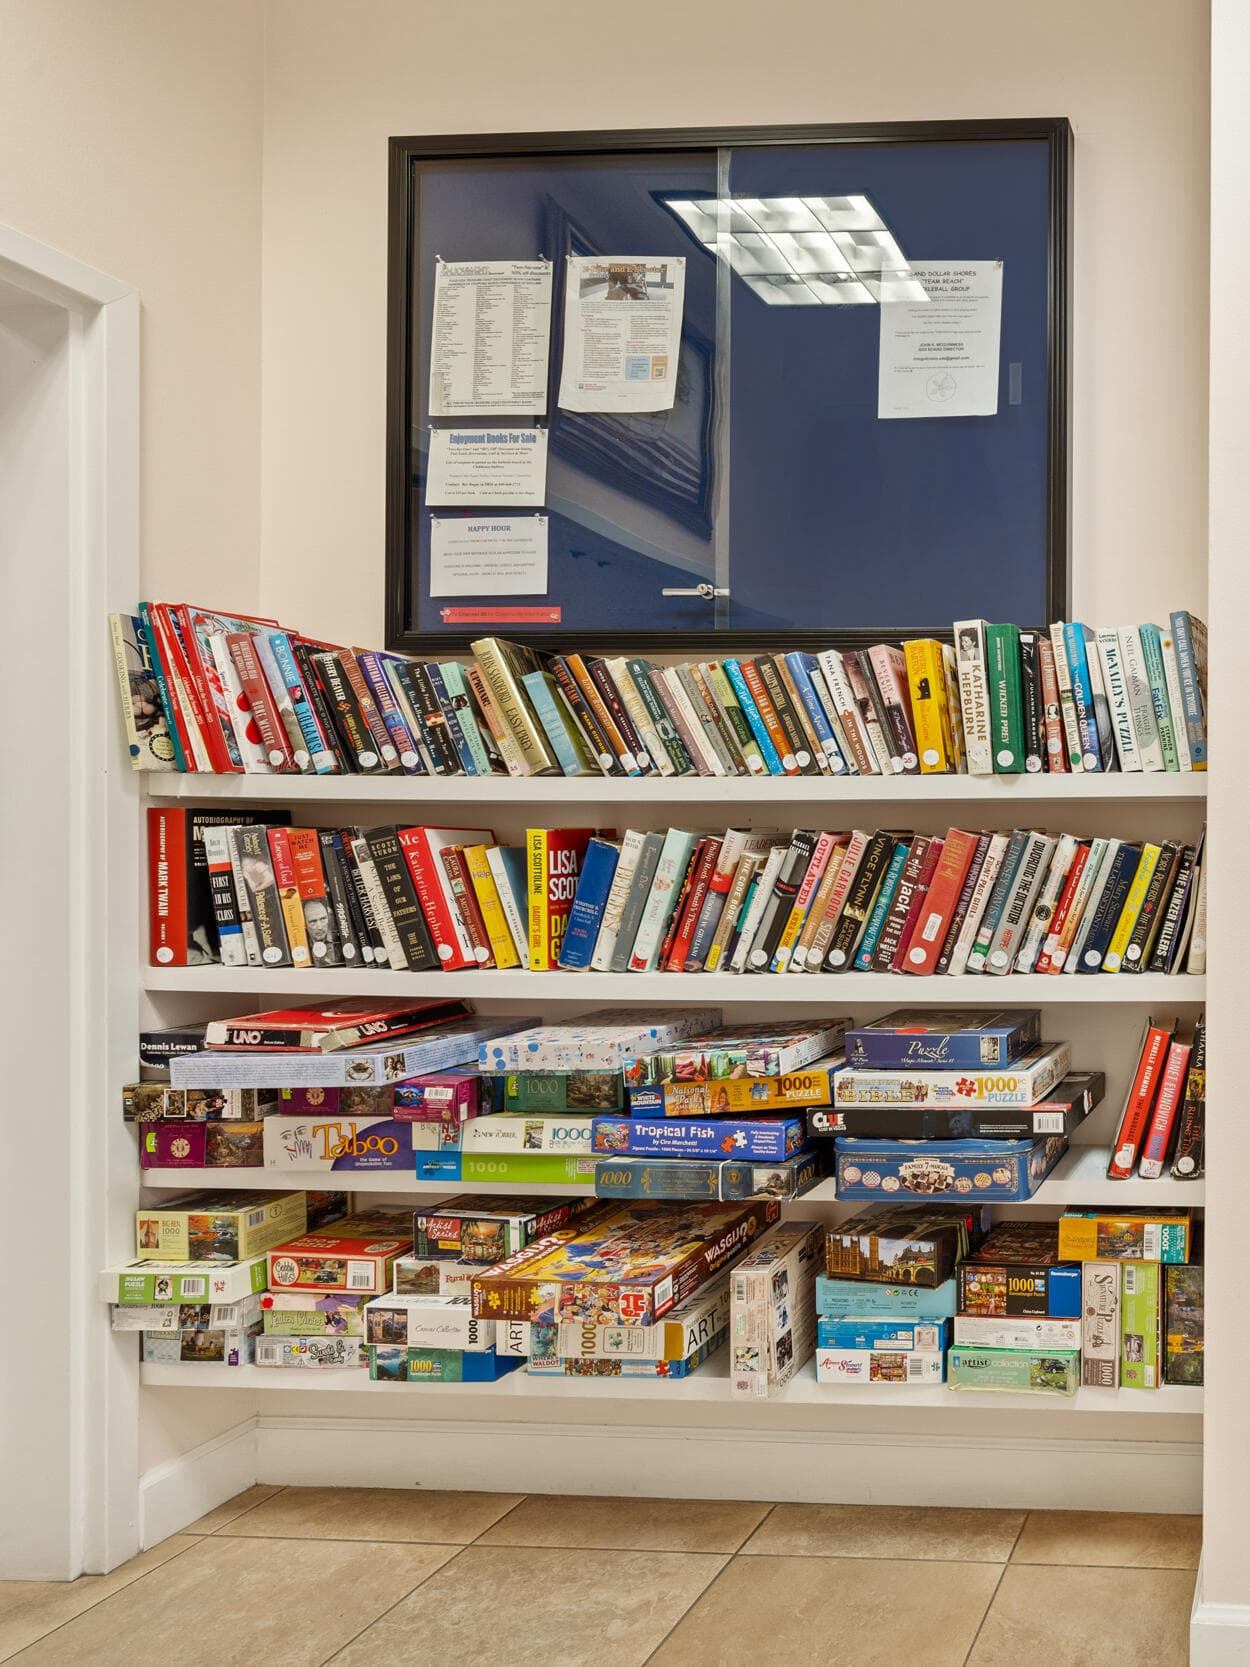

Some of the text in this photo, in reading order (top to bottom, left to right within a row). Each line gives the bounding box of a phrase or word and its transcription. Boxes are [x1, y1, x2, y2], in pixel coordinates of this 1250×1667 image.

[450, 433, 536, 445] Enjoyment Books For Sale
[276, 644, 296, 683] BONNIE
[469, 669, 492, 708] UPROAR!
[960, 671, 977, 736] HEPBURN
[969, 664, 988, 742] KATHARINE
[506, 706, 534, 753] EASY PREY
[824, 655, 868, 770] TANA FRENCH IN THE WOODS
[997, 680, 1010, 744] WICKED PREY
[1074, 683, 1091, 749] GOLDEN QUEEN
[1117, 711, 1133, 754] PUZZLE
[400, 834, 419, 846] Me
[408, 850, 430, 902] Katharine
[550, 850, 577, 874] LISA
[700, 840, 719, 880] Philip Roth
[797, 837, 830, 907] OUTLAWED
[824, 836, 864, 921] JULIE GARWOOD
[853, 836, 887, 906] VINCE FLYNN
[156, 861, 171, 916] MARK TWAIN
[530, 835, 546, 949] LISA SCOTTOLINE GIRL
[726, 857, 753, 921] THE CODE BOOK
[893, 879, 917, 915] jack
[989, 844, 1021, 918] LINDSEY DAVIS
[1156, 868, 1191, 957] THE PANZER KILLERS
[141, 1042, 167, 1051] Dennis
[232, 1031, 261, 1045] UNO
[362, 1021, 387, 1035] UNO
[908, 1036, 950, 1057] Puzzle
[775, 1076, 813, 1089] 1000
[976, 1077, 1018, 1093] 1000
[1139, 1035, 1161, 1097] MICHELLE RICHMOND
[786, 1088, 821, 1097] PUZZLE
[843, 1090, 914, 1102] BIBLE
[988, 1092, 1027, 1102] PUZZLE
[1153, 1053, 1184, 1131] JANET EVANOVICH
[551, 1127, 592, 1140] 1000
[635, 1125, 715, 1138] Tropical Fish
[812, 1113, 845, 1128] CLUE
[313, 1122, 398, 1161] Taboo
[469, 1162, 508, 1172] 1000
[1008, 1278, 1034, 1292] 1000
[469, 1320, 478, 1344] 1000
[509, 1321, 523, 1353] ART
[687, 1310, 718, 1354] ART
[410, 1361, 432, 1372] 1000
[1102, 1362, 1112, 1384] 1000
